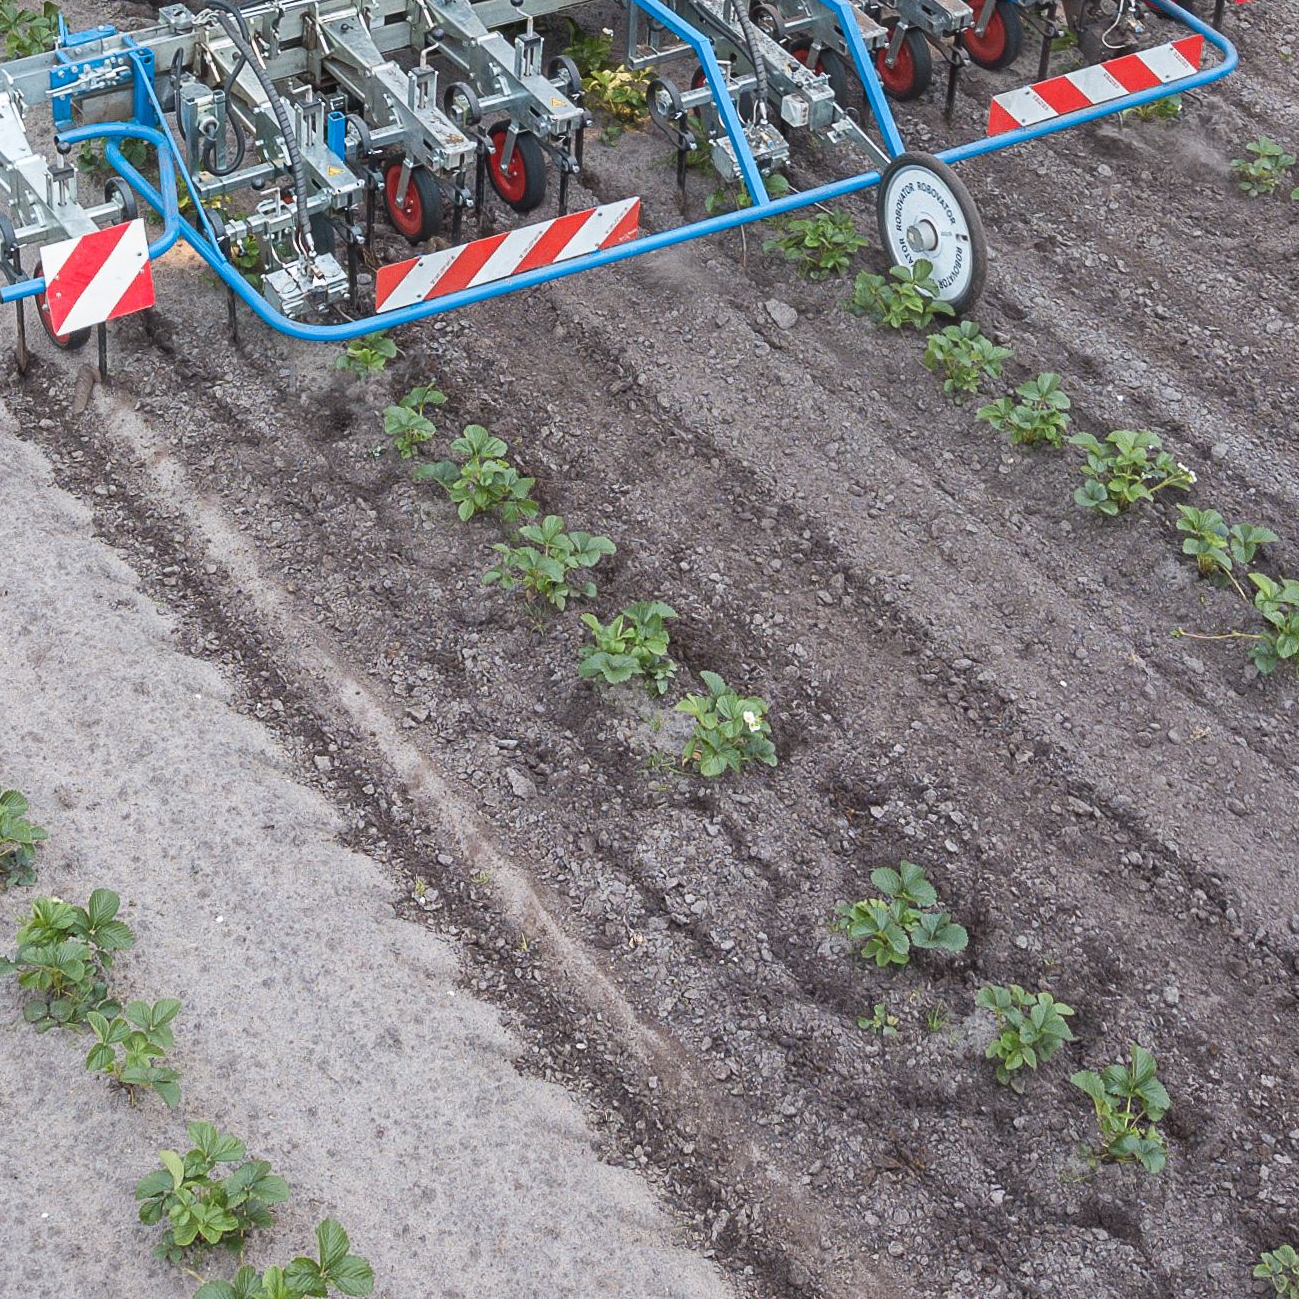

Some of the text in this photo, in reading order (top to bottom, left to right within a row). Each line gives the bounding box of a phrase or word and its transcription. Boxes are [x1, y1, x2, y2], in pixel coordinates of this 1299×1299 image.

[895, 182, 915, 231] ROBOVATOR
[917, 181, 956, 225] ROBOVATOR
[937, 246, 963, 289] ROBOVATOR
